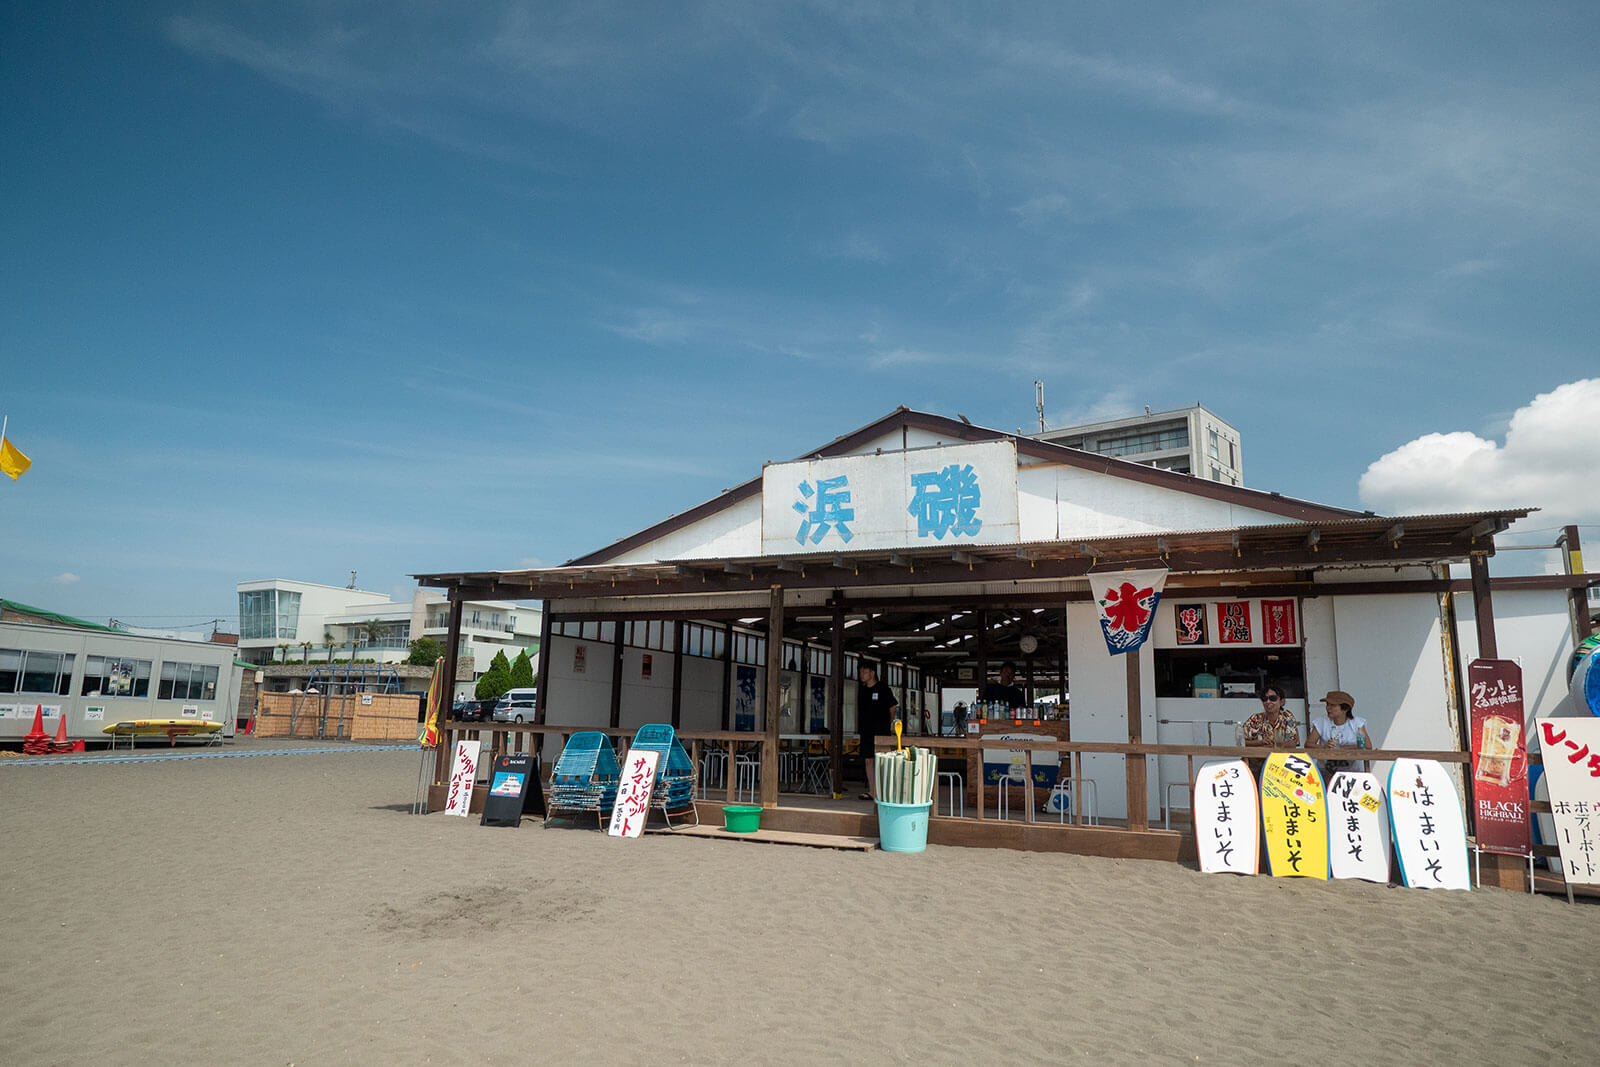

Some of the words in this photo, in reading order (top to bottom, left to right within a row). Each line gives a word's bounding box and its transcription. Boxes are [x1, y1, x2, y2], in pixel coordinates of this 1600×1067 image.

[1104, 582, 1154, 632] 氷
[459, 744, 476, 774] レンタル
[1230, 767, 1240, 779] 3
[446, 771, 464, 810] パラソル
[637, 767, 655, 814] レンタル
[1362, 779, 1372, 791] 6
[1479, 799, 1524, 814] BLACK
[1212, 780, 1234, 867] はまいそ
[1284, 803, 1302, 872] はまいそ
[1307, 809, 1317, 823] 5
[1342, 799, 1363, 861] はまいそ
[1413, 787, 1443, 882] はまいそ
[1480, 809, 1523, 820] HIGHBALL
[1554, 801, 1580, 876] ボート
[1574, 801, 1594, 877] ボディーボード
